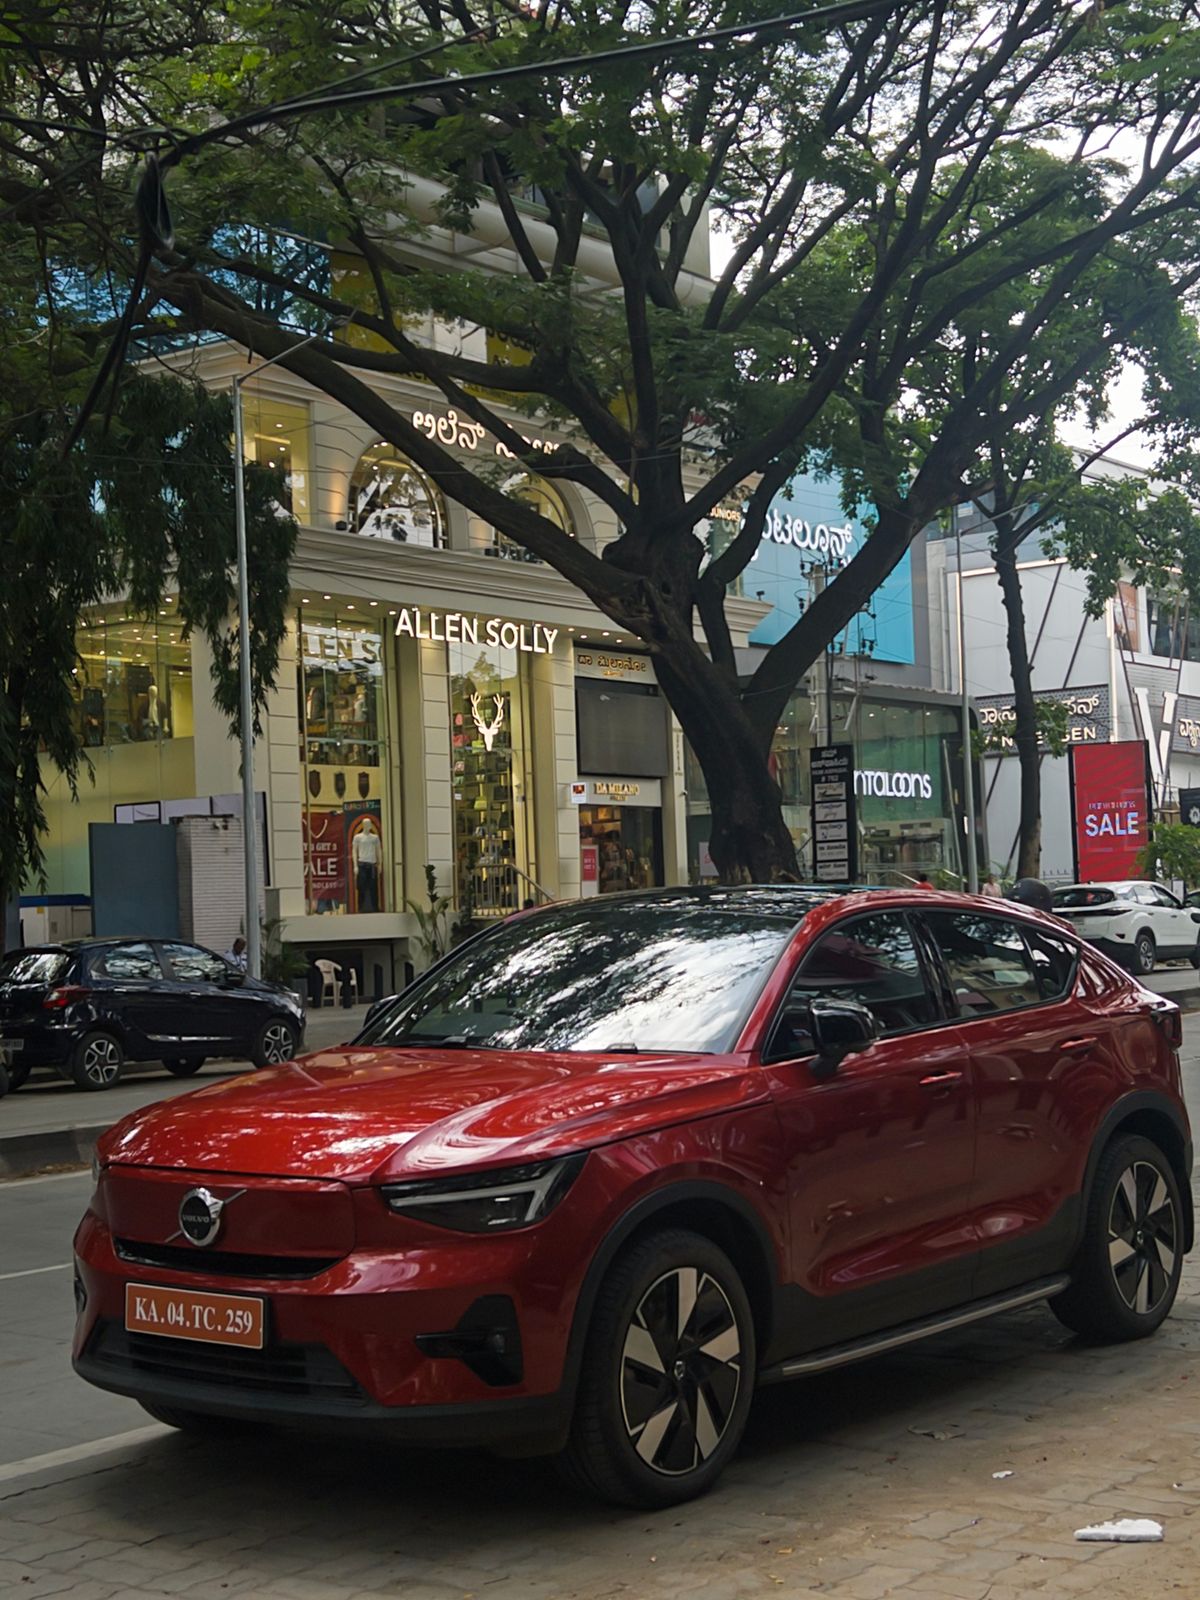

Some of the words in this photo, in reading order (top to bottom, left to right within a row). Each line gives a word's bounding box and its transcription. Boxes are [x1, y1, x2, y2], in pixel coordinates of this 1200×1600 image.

[395, 607, 479, 645] ALLEN
[486, 618, 559, 654] SOLLY
[1084, 811, 1140, 837] SALE
[303, 857, 339, 877] ALE
